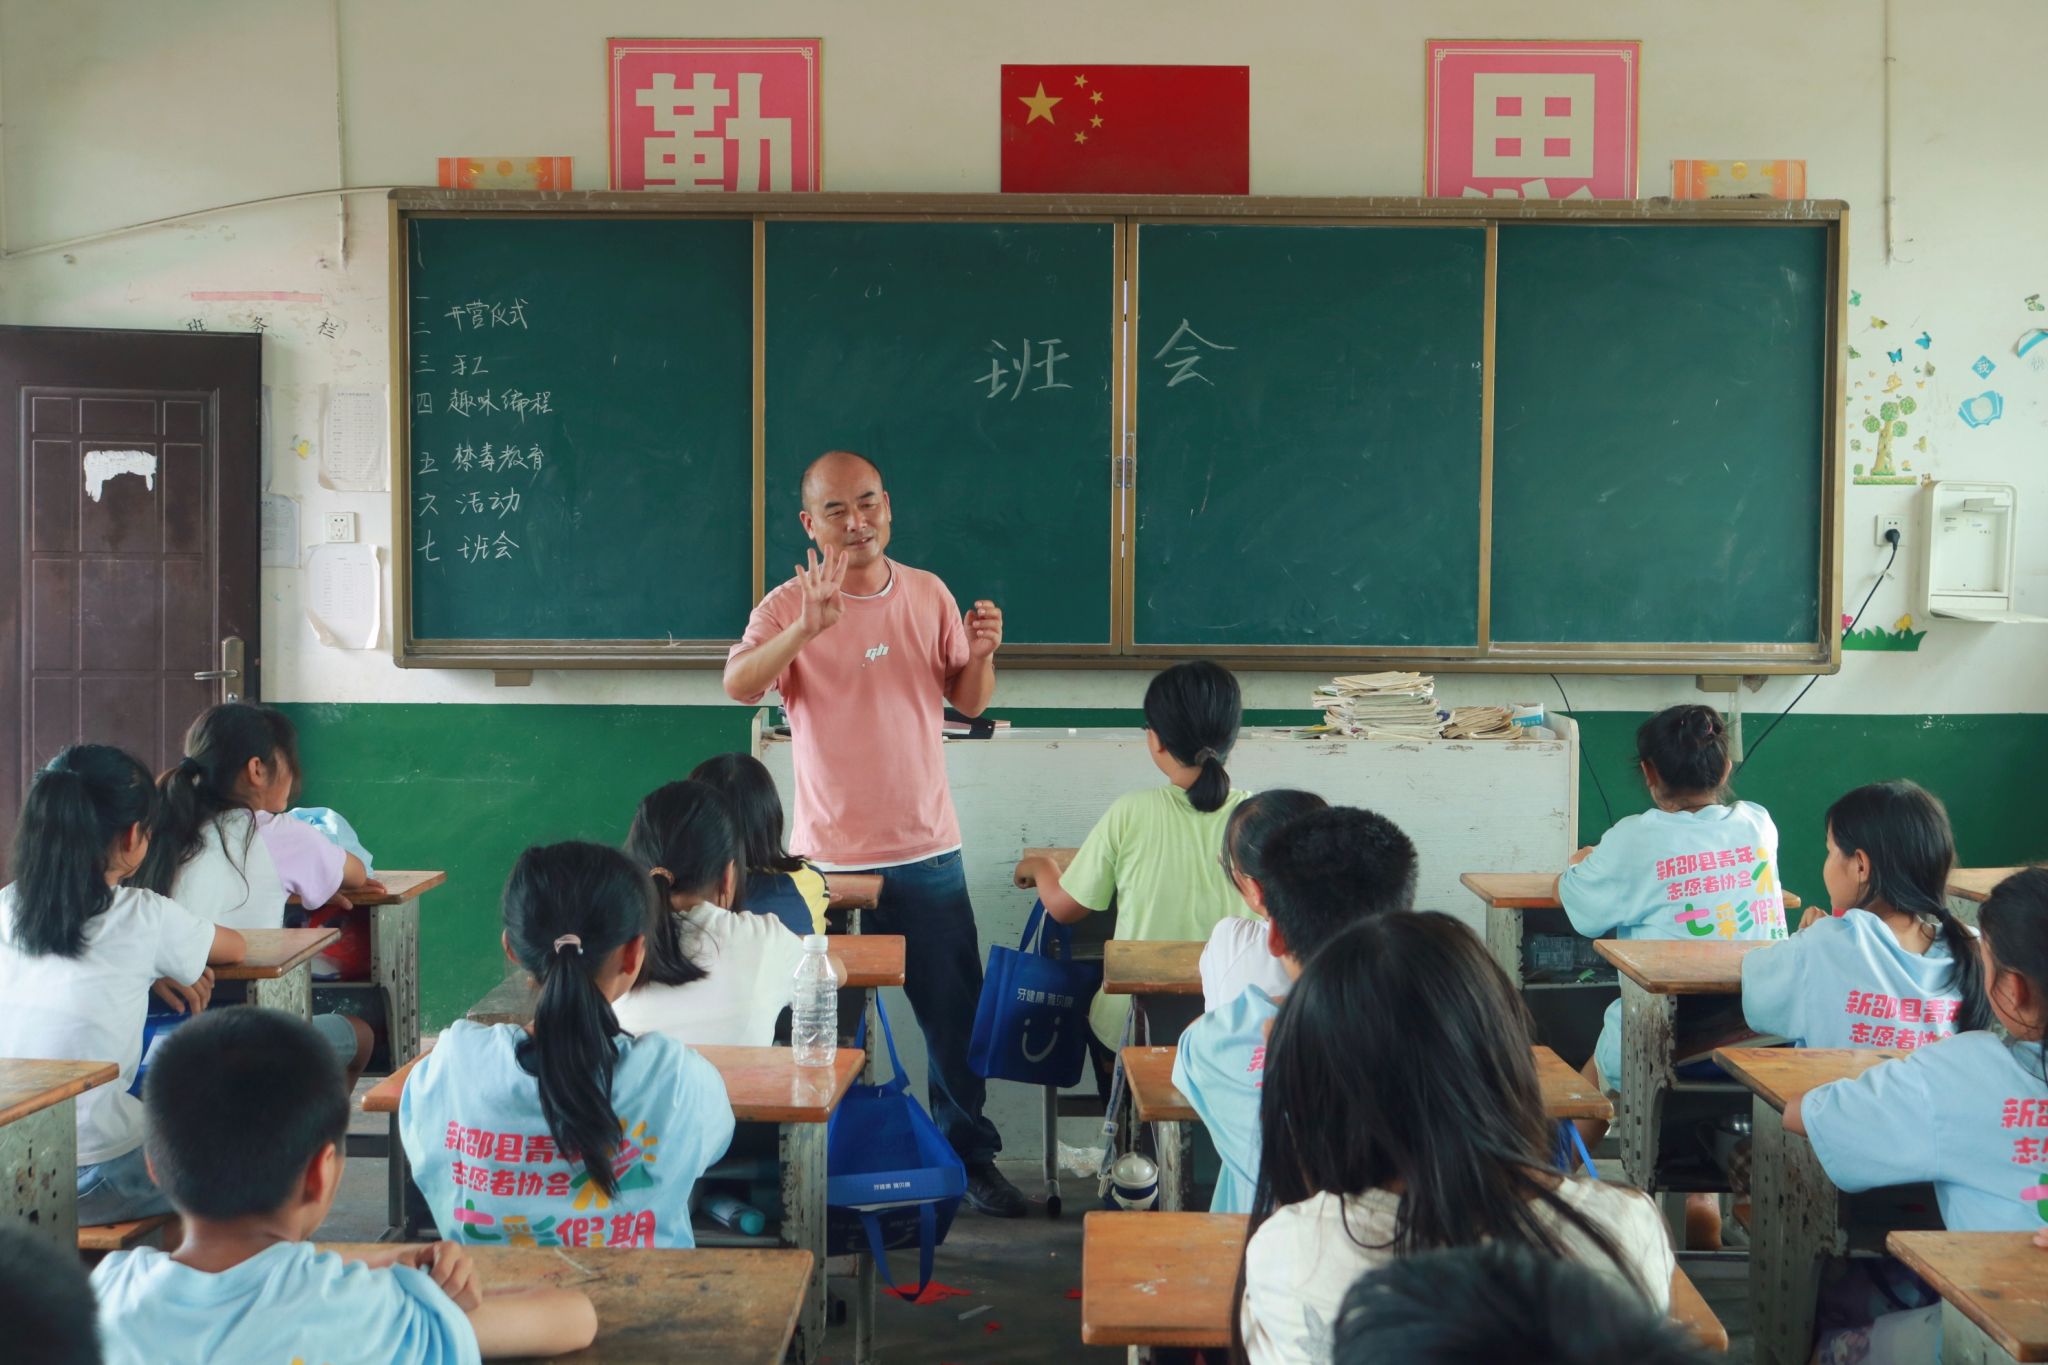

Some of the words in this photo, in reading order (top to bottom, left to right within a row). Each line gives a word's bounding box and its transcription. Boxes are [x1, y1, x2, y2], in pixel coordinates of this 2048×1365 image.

[635, 72, 793, 192] 勤
[444, 298, 529, 332] 开营仪式
[415, 353, 436, 373] 三
[416, 392, 433, 414] 四
[447, 388, 553, 424] 趣味编程
[417, 451, 439, 475] 五
[452, 440, 545, 474] 禁毒教育
[418, 492, 439, 517] 六
[455, 487, 521, 520] 活动
[417, 529, 440, 562] 七
[456, 530, 520, 564] 班会
[1656, 845, 1756, 881] 新邵县青年
[1666, 870, 1753, 901] 志愿者协会
[2011, 1135, 2048, 1165] 志
[451, 1160, 572, 1197] 志愿者协会
